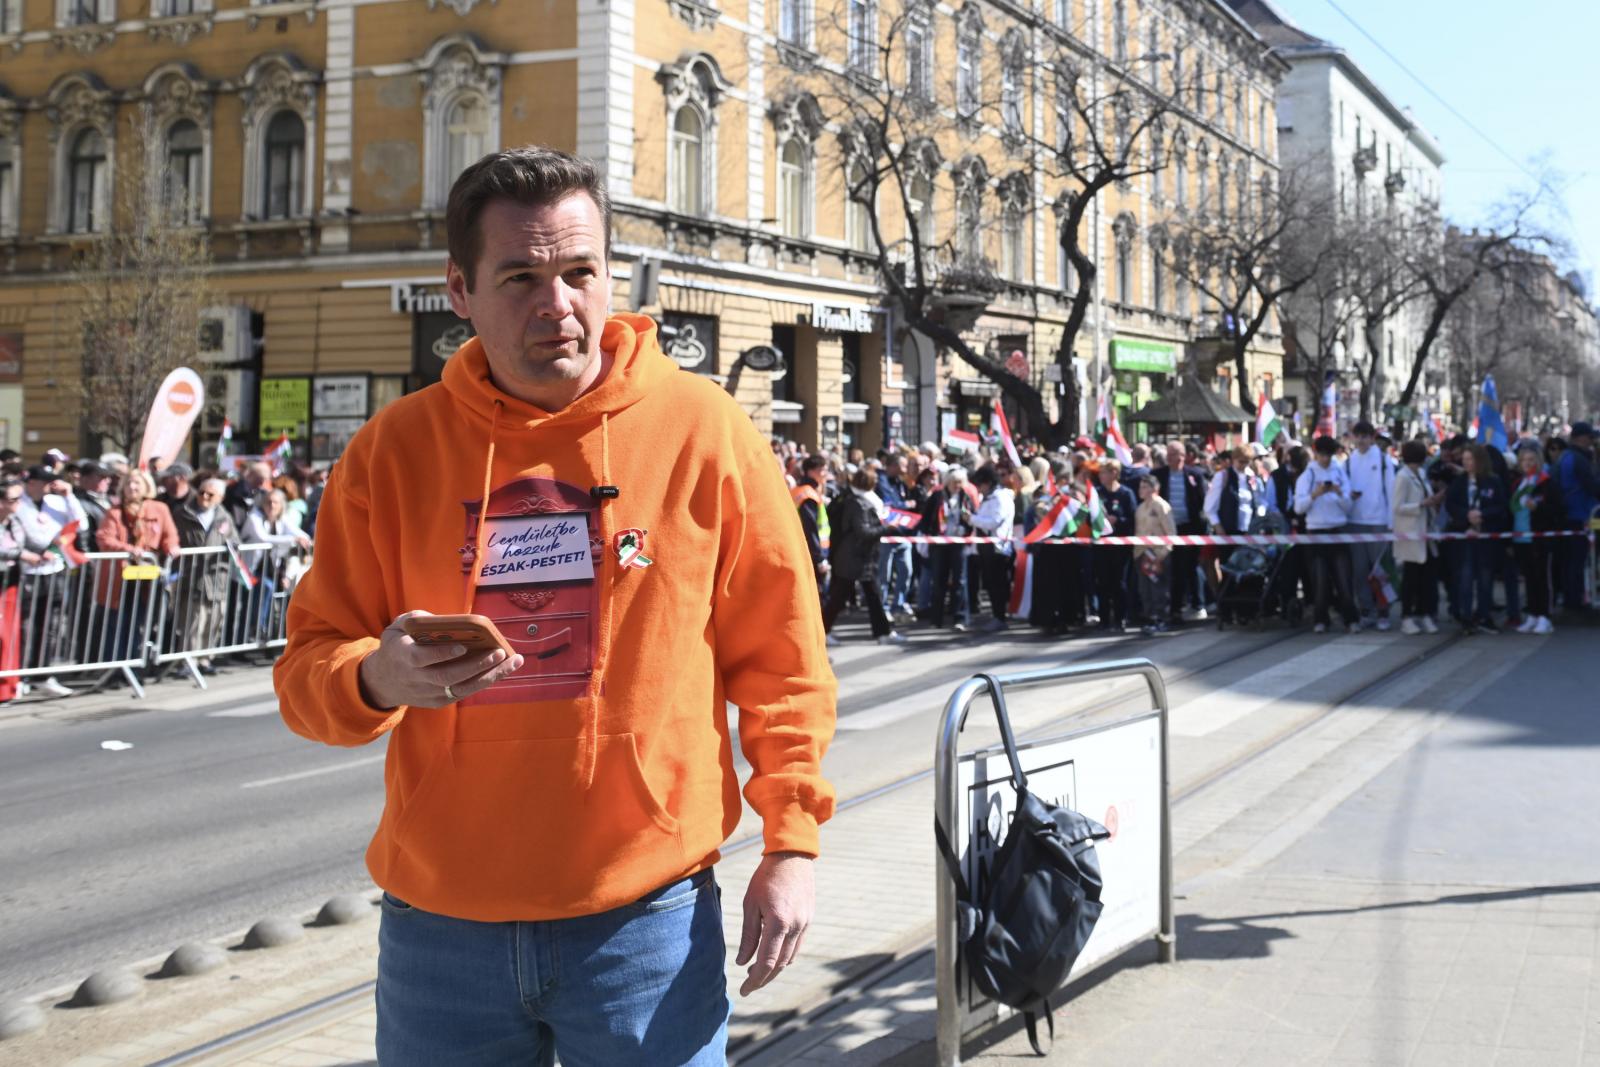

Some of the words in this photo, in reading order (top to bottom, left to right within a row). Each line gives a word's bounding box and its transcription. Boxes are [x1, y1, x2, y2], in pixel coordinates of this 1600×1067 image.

[487, 521, 579, 547] Lendületbe
[502, 537, 562, 560] hozzuk
[480, 550, 585, 577] ÉSZAK-PESTET!
